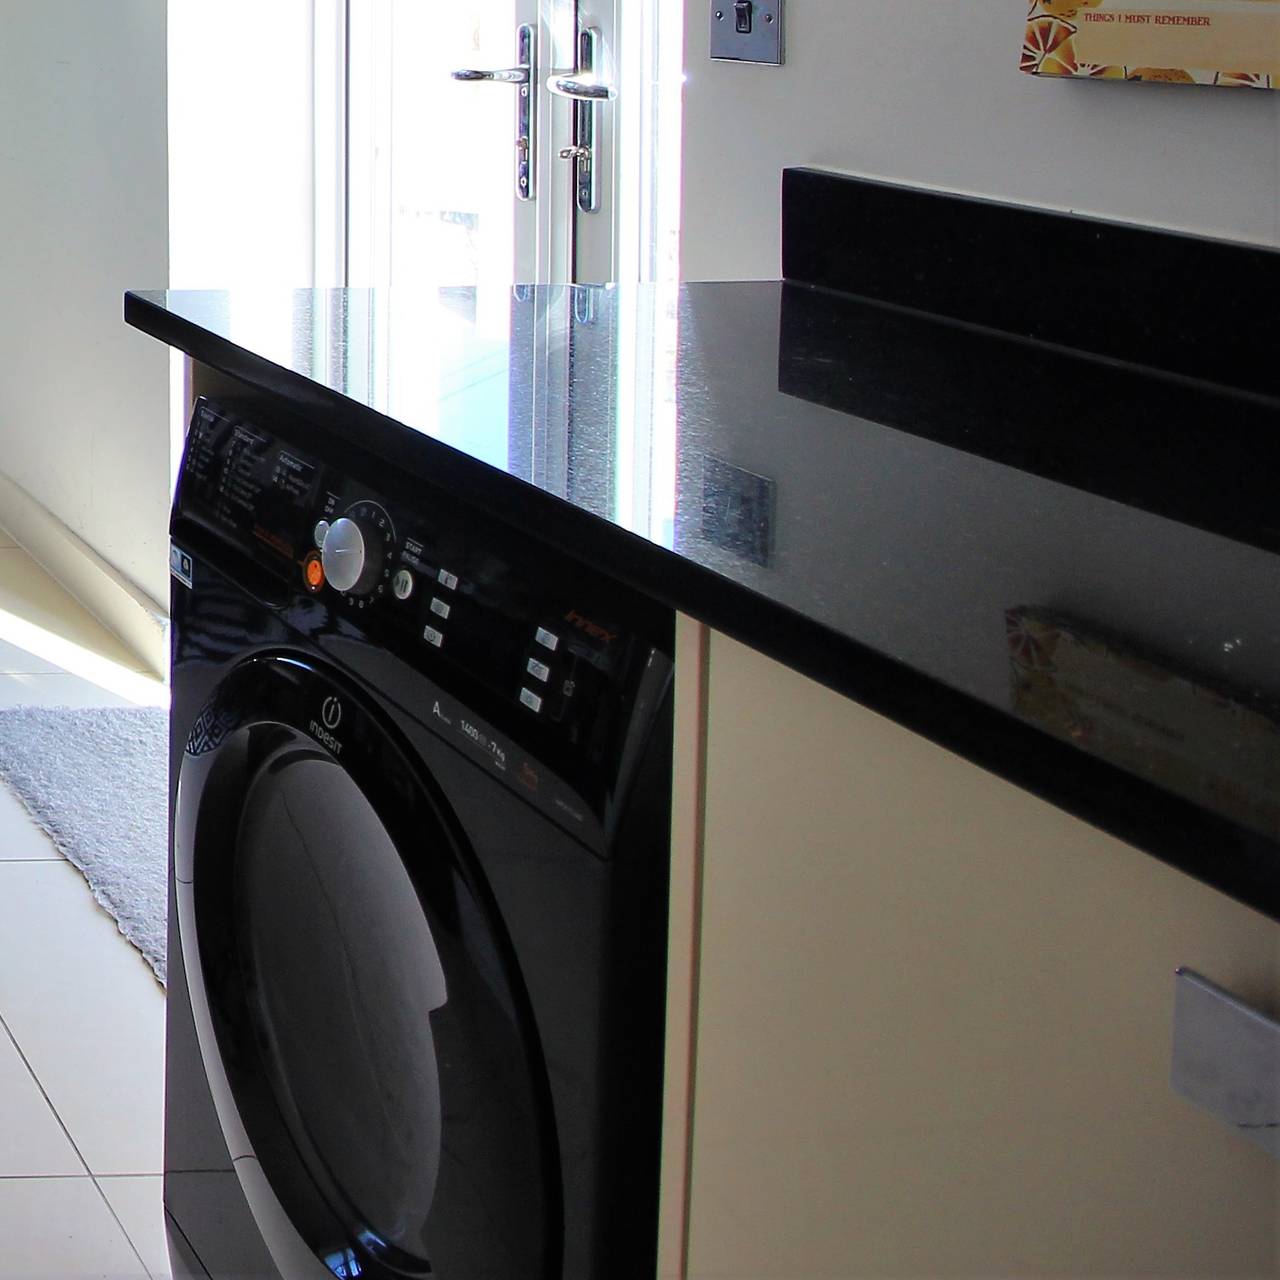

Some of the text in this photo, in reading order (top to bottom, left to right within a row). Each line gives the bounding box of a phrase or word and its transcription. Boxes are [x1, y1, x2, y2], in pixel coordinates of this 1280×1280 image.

[1085, 13, 1115, 22] THINGS
[1124, 14, 1151, 24] MUST
[1154, 15, 1211, 26] REMEMBER
